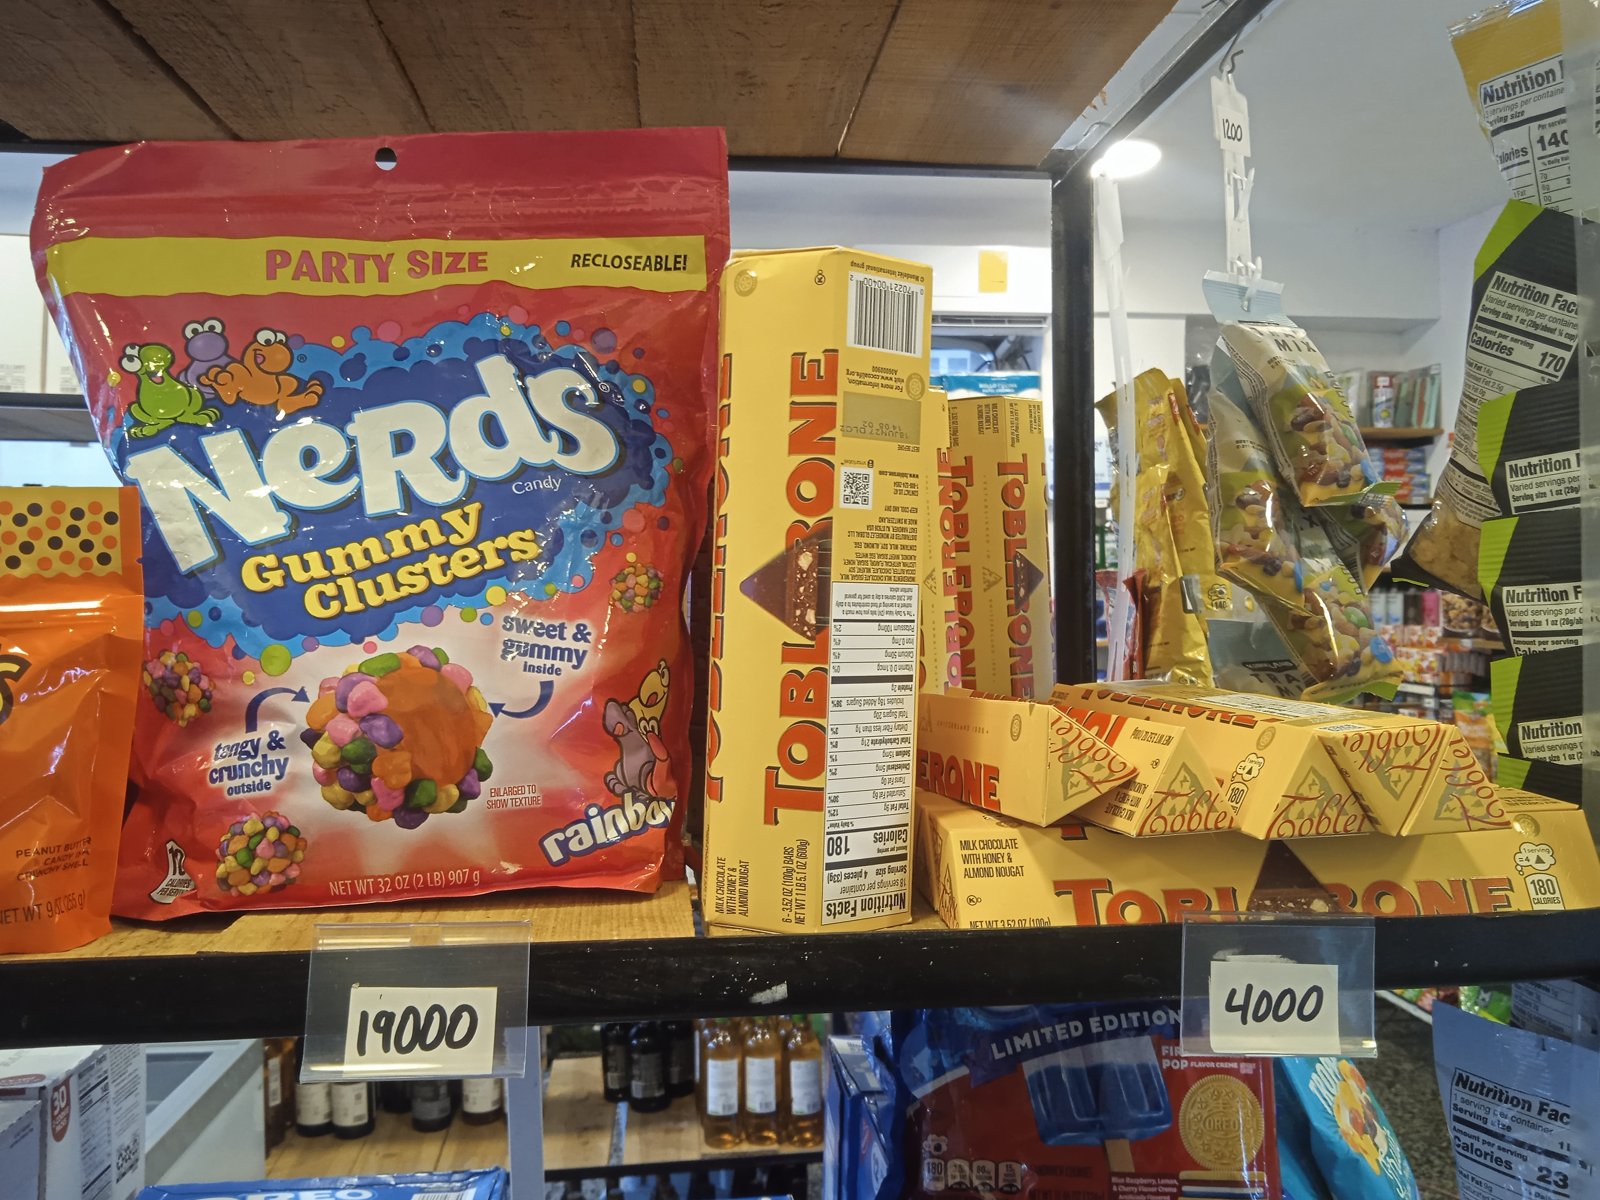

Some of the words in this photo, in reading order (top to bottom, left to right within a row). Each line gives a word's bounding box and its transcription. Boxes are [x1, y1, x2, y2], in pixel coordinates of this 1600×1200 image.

[1483, 67, 1556, 105] Nutrition
[1510, 109, 1526, 120] size
[1222, 118, 1243, 142] 1200
[265, 249, 394, 284] PARTY
[406, 249, 488, 280] SIZE
[570, 252, 688, 273] RECLOSEABLE!
[889, 282, 911, 295] 70221
[1491, 275, 1550, 306] Nutrition
[1551, 293, 1579, 316] Fact
[1480, 304, 1502, 317] Serving
[1501, 310, 1513, 320] size
[1485, 294, 1507, 308] Varied
[1507, 301, 1535, 317] servings
[1535, 310, 1548, 321] per
[1273, 338, 1317, 352] MIX
[1474, 323, 1498, 337] Amount
[1498, 331, 1510, 340] per
[1510, 335, 1535, 350] serving
[1470, 331, 1515, 357] Calories
[1538, 351, 1566, 373] 170
[1508, 457, 1571, 479] Nutrition
[511, 474, 562, 495] Candy
[1509, 480, 1534, 492] Varied
[1535, 477, 1566, 490] servings
[1567, 475, 1580, 486] per
[1511, 493, 1535, 504] Serving
[1535, 490, 1547, 499] size
[239, 500, 483, 592] Gummy
[303, 526, 543, 620] Clusters
[937, 447, 962, 692] OBLERONE
[764, 348, 839, 826] TOBLRONE
[1505, 588, 1570, 604] Nutrition
[1506, 608, 1529, 617] Varied
[1530, 607, 1563, 618] servings
[1565, 607, 1578, 616] per
[501, 615, 568, 641] sweet
[572, 623, 592, 644] &
[1508, 619, 1529, 629] Serving
[1530, 618, 1543, 627] size
[1513, 638, 1537, 646] Amount
[1538, 638, 1549, 647] per
[1551, 637, 1579, 647] serving
[500, 638, 588, 671] gummy
[522, 660, 562, 677] inside
[1521, 721, 1582, 741] Nutrition
[214, 737, 262, 761] tangy
[266, 729, 287, 752] &
[1522, 744, 1543, 755] Varied
[1544, 742, 1578, 754] servings
[208, 753, 289, 785] crunchy
[226, 778, 272, 797] outside
[894, 776, 906, 784] Trans
[490, 784, 525, 798] ENLARGED
[526, 784, 537, 794] TO
[886, 789, 906, 798] Saturated
[1227, 786, 1245, 805] 180
[486, 798, 509, 810] SHOW
[509, 795, 542, 808] TEXTURE
[897, 802, 909, 810] Total
[828, 809, 839, 818] 12%
[827, 835, 850, 857] 180
[873, 829, 908, 846] Calories
[960, 839, 977, 851] MILK
[978, 838, 1018, 850] CHOCOLATE
[15, 844, 62, 859] PEANUT
[783, 846, 795, 865] BARS
[796, 838, 810, 862] (600g)
[961, 853, 981, 865] WITH
[982, 852, 1005, 864] HONEY
[1006, 852, 1012, 863] &
[716, 856, 727, 895] CHOCOLATE
[739, 860, 750, 888] NOUGAT
[782, 866, 796, 886] (100g)
[827, 872, 843, 884] (33g)
[844, 869, 863, 880] pieces
[875, 868, 886, 877] size
[888, 864, 907, 876] Serving
[963, 866, 994, 879] ALMOND
[995, 865, 1024, 878] NOUGAT
[329, 880, 352, 896] NET
[354, 878, 374, 895] WT
[378, 877, 392, 894] 32
[395, 874, 411, 890] OZ
[413, 873, 425, 890] (2
[427, 870, 446, 889] LB)
[448, 868, 470, 886] 907
[472, 869, 480, 887] g
[727, 873, 737, 895] HONEY
[783, 886, 793, 896] OZ
[840, 883, 866, 895] container
[866, 880, 877, 891] per
[877, 879, 899, 890] servings
[1530, 878, 1556, 896] 180
[714, 896, 725, 914] MILK
[726, 895, 736, 915] WITH
[738, 888, 749, 917] ALMOND
[782, 897, 793, 913] 3.52
[795, 897, 806, 909] WT
[826, 899, 857, 919] Facts
[861, 892, 906, 914] Nutrition
[1532, 896, 1561, 905] CALORIES
[22, 903, 43, 922] WT
[794, 909, 805, 925] NET
[1224, 982, 1324, 1026] 4000
[356, 1003, 479, 1057] 19000
[990, 1021, 1084, 1059] LIMITED
[1088, 1009, 1182, 1033] EDITION
[1162, 1058, 1188, 1070] POP
[1190, 1061, 1215, 1069] FLAVOR
[53, 1084, 68, 1113] 30
[1455, 1072, 1532, 1112] Nutrition
[1536, 1101, 1571, 1126] Fac
[1453, 1103, 1488, 1125] Serving
[1460, 1096, 1491, 1115] serving
[1510, 1113, 1554, 1135] container
[1205, 1117, 1239, 1131] OREO
[1453, 1126, 1481, 1143] Amount
[1482, 1136, 1497, 1149] per
[1497, 1144, 1528, 1162] serving
[1454, 1134, 1514, 1171] Calories
